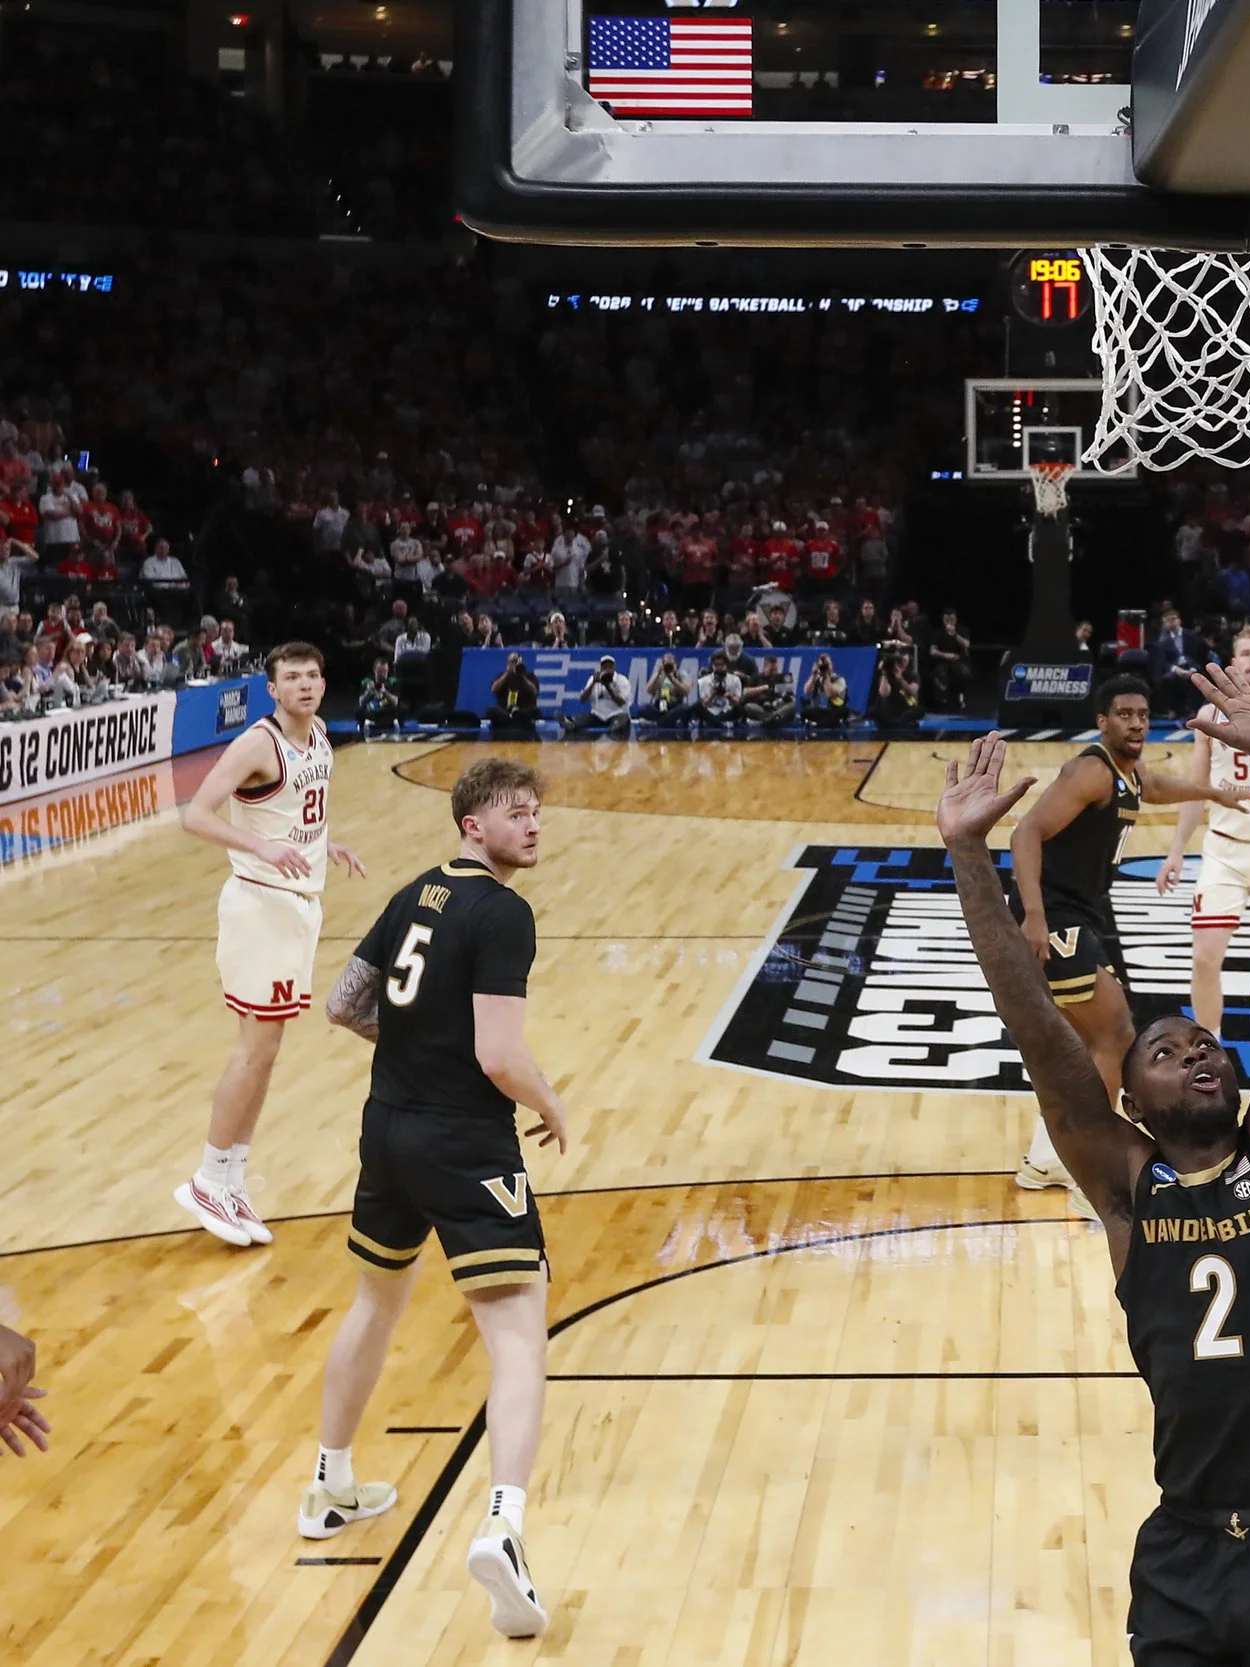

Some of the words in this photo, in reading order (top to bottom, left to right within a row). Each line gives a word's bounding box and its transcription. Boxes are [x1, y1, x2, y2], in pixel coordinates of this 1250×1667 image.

[1030, 260, 1081, 281] 19:06
[1042, 281, 1077, 320] 17
[1026, 667, 1069, 681] MARCH
[1031, 681, 1089, 694] MADNESS
[20, 730, 40, 789] 12
[45, 704, 158, 780] CONFERENCE
[293, 763, 329, 793] NEBRASK
[303, 786, 324, 825] 21
[1048, 925, 1082, 959] V
[386, 921, 435, 1008] 5
[270, 979, 295, 1004] N
[480, 1171, 529, 1218] V
[1189, 1253, 1245, 1361] 2
